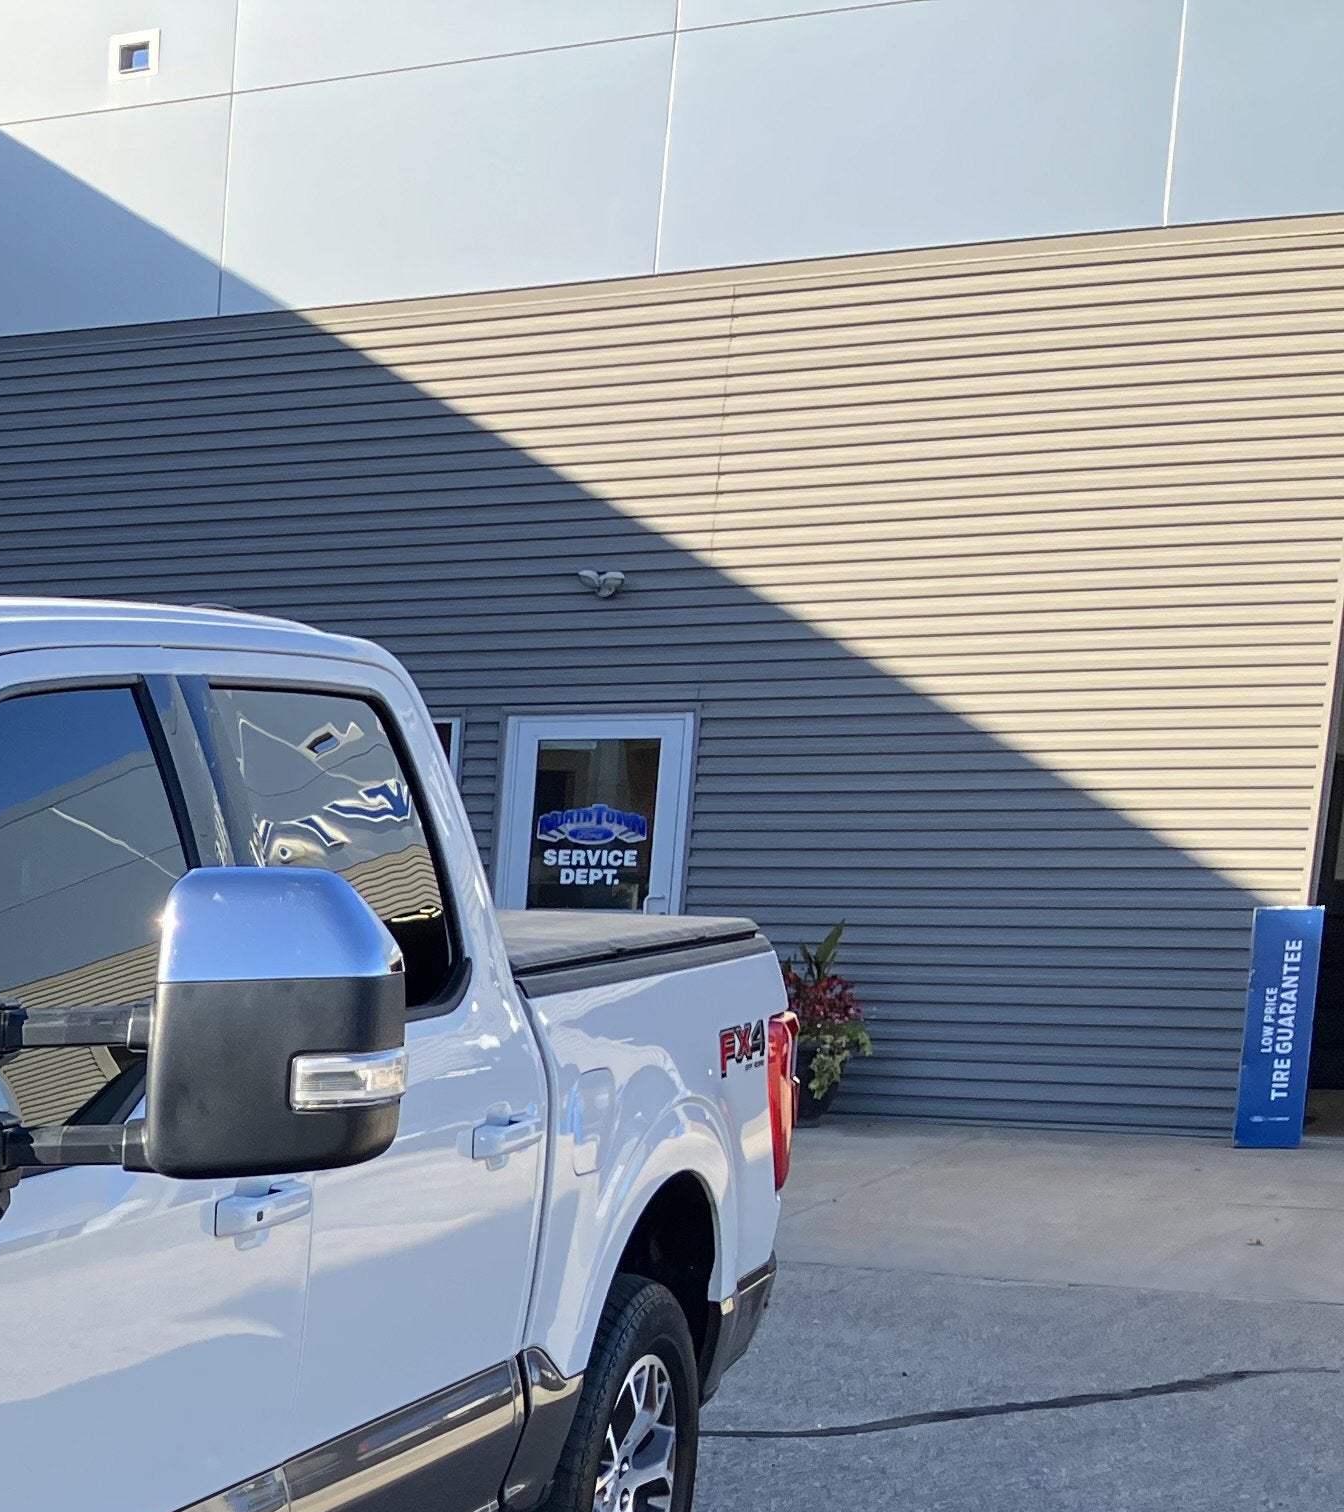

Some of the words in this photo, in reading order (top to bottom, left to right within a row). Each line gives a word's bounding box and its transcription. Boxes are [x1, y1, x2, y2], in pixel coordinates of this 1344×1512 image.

[543, 849, 638, 866] SERVICE
[559, 868, 619, 885] DEPT.
[1264, 987, 1278, 1023] PRICE
[1276, 939, 1303, 1054] GUARANTEE
[719, 1020, 765, 1079] FX4
[1261, 1026, 1275, 1053] LOW
[1271, 1058, 1291, 1101] TIRE
